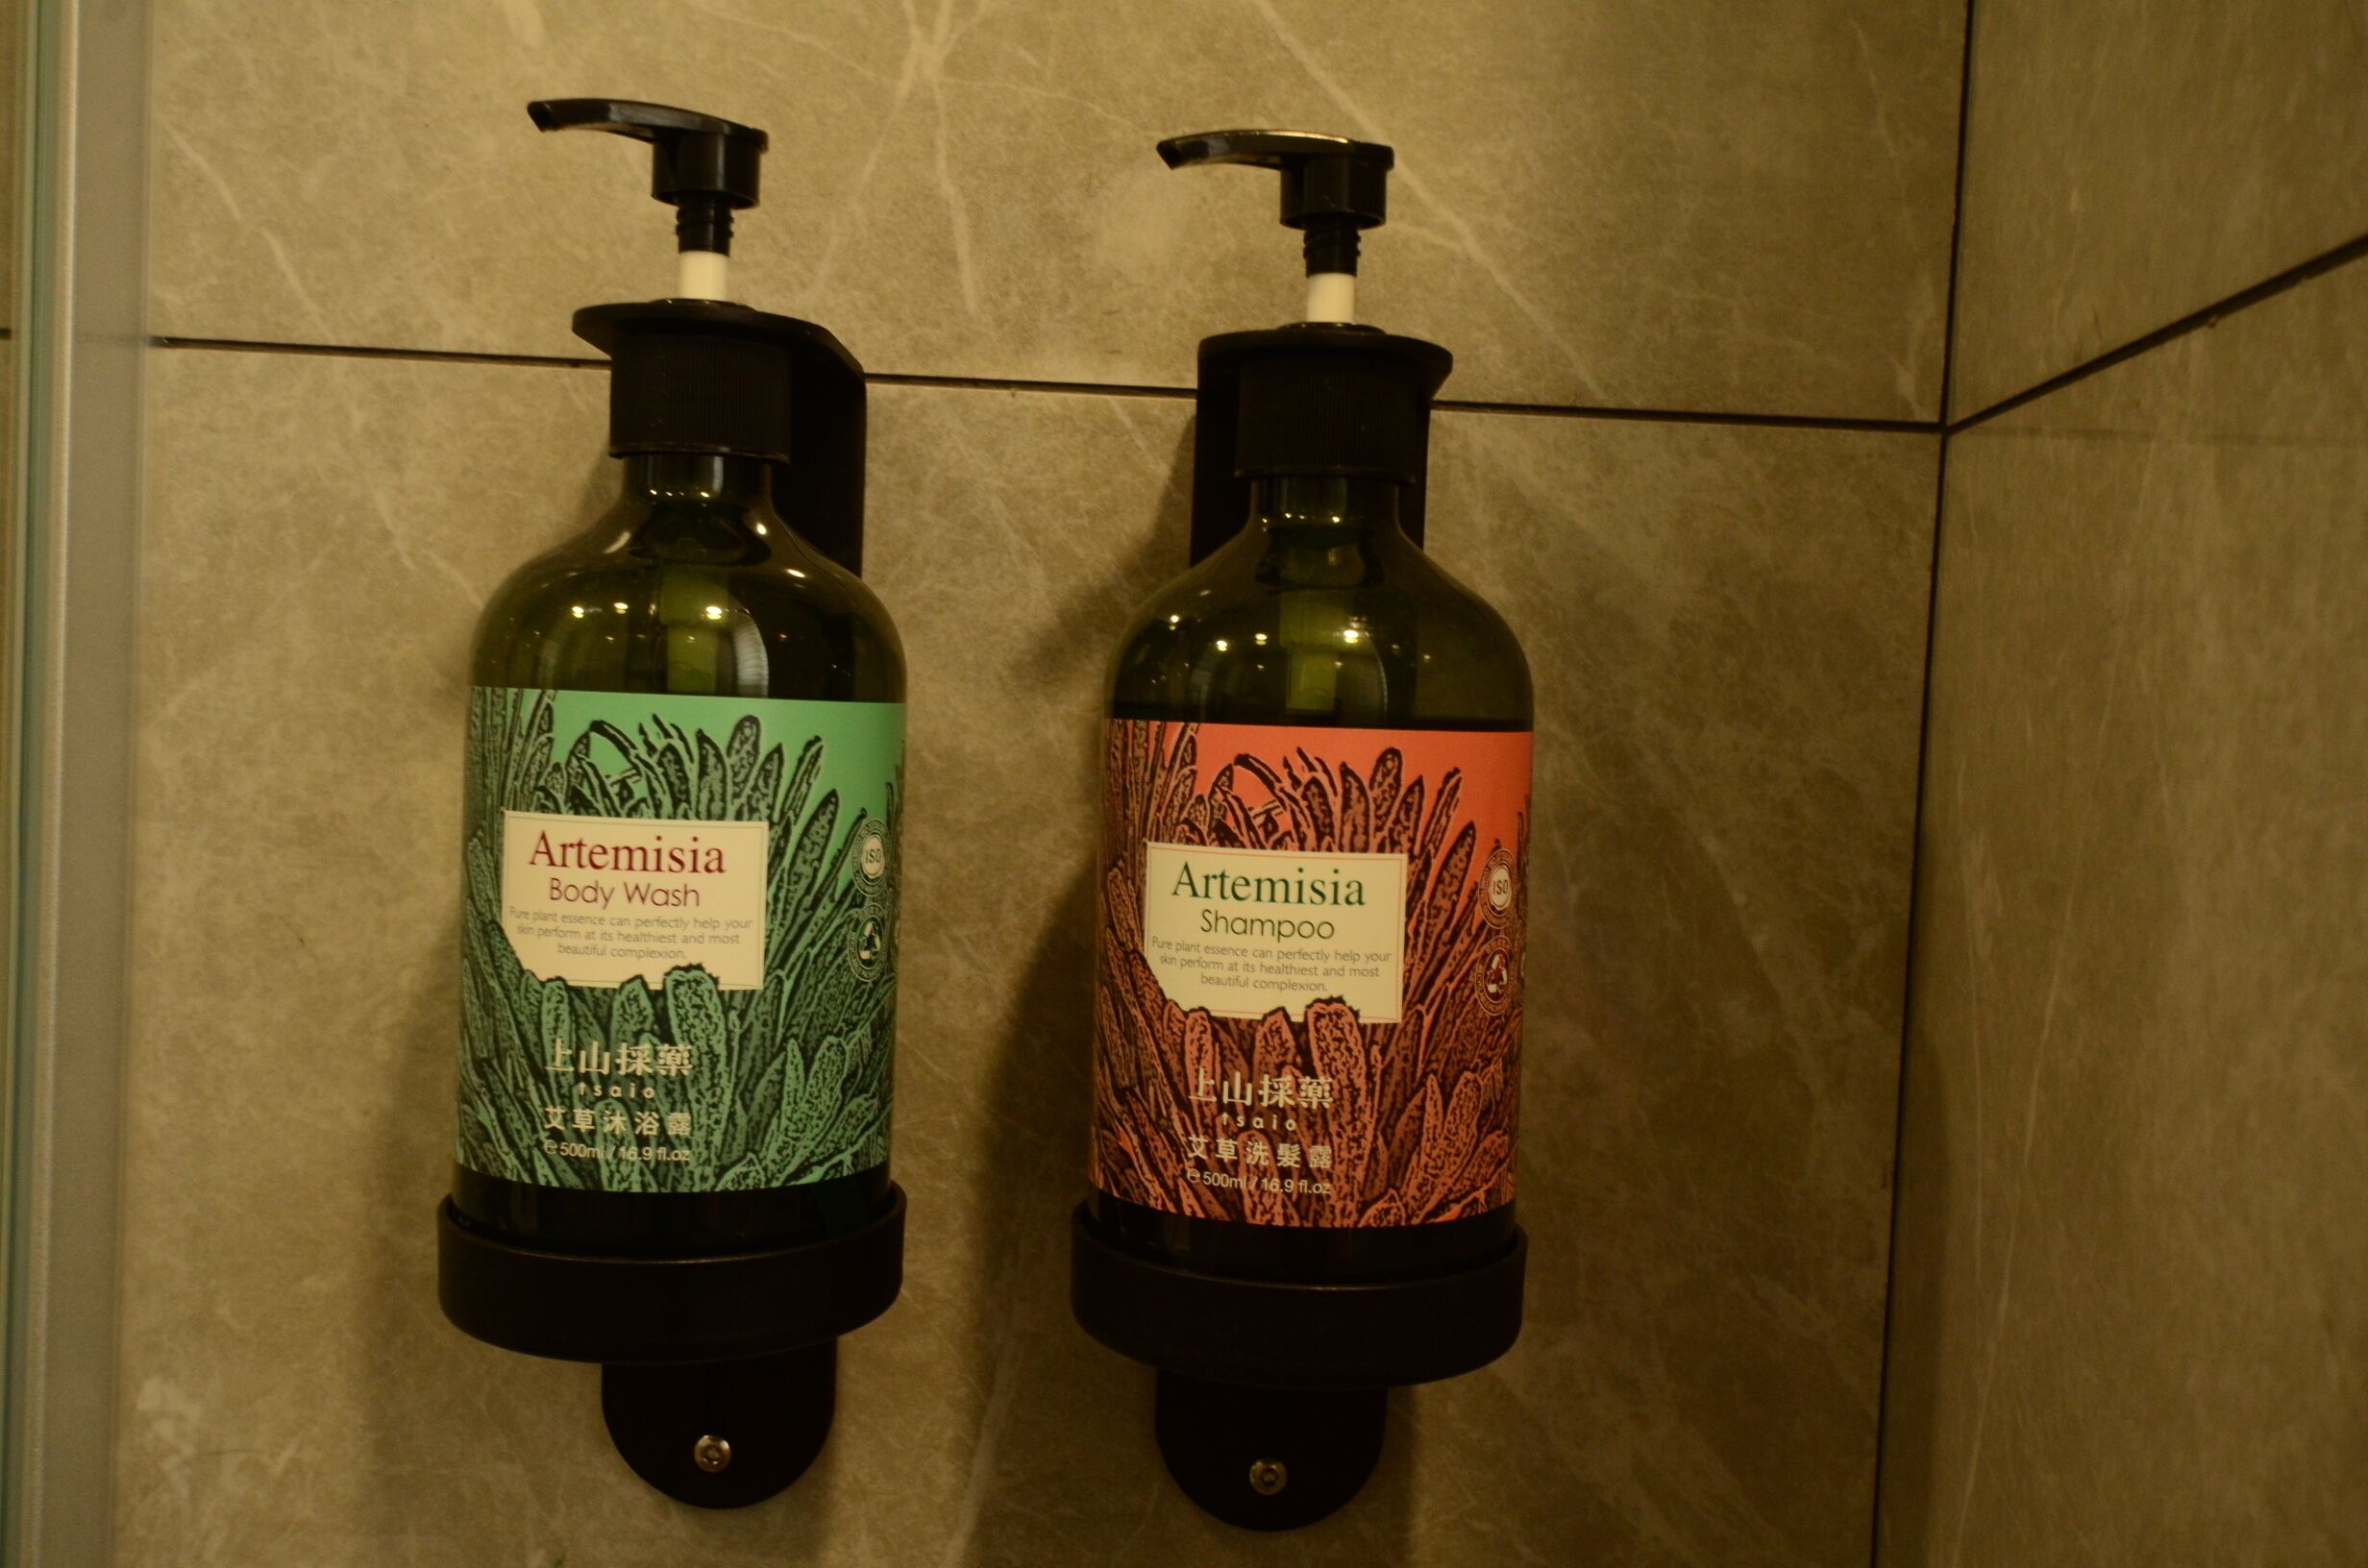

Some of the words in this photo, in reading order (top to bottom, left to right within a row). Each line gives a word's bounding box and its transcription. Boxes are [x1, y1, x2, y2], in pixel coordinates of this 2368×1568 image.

[529, 829, 727, 874] Artemisia
[866, 848, 881, 864] ISO
[549, 877, 615, 910] Body
[623, 882, 700, 907] Wash
[1172, 861, 1367, 906] Artemisia
[1492, 880, 1508, 894] ISO
[509, 906, 530, 920] Pure
[532, 910, 557, 924] plant
[561, 915, 605, 926] essence
[610, 918, 631, 927] can
[634, 917, 690, 931] perfectly
[693, 917, 720, 931] help
[725, 919, 752, 932] your
[1200, 909, 1335, 943] Shampoo
[537, 925, 581, 940] perform
[584, 929, 597, 941] at
[600, 928, 615, 942] its
[618, 930, 678, 943] healthiest
[682, 931, 705, 944] and
[709, 933, 740, 944] most
[558, 943, 606, 957] beautiful
[610, 945, 687, 960] complexion.
[1152, 936, 1172, 950] Pure
[1175, 940, 1200, 955] plant
[1204, 945, 1247, 957] essence
[1252, 948, 1272, 959] can
[1277, 949, 1331, 963] perfectly
[1334, 950, 1361, 964] help
[1365, 951, 1392, 964] your
[1159, 953, 1177, 967] skin
[1180, 956, 1223, 971] perform
[1227, 960, 1240, 972] at
[1243, 961, 1255, 973] its
[1260, 963, 1319, 976] healthiest
[1322, 964, 1345, 977] and
[1349, 967, 1379, 977] most
[1201, 974, 1249, 989] beautiful
[1253, 977, 1328, 992] complexion.
[580, 1082, 655, 1099] tsaio
[544, 1106, 692, 1137] 艾草沐浴露
[1221, 1113, 1296, 1131] tsaio
[1188, 1135, 1332, 1168] 艾草洗髮露
